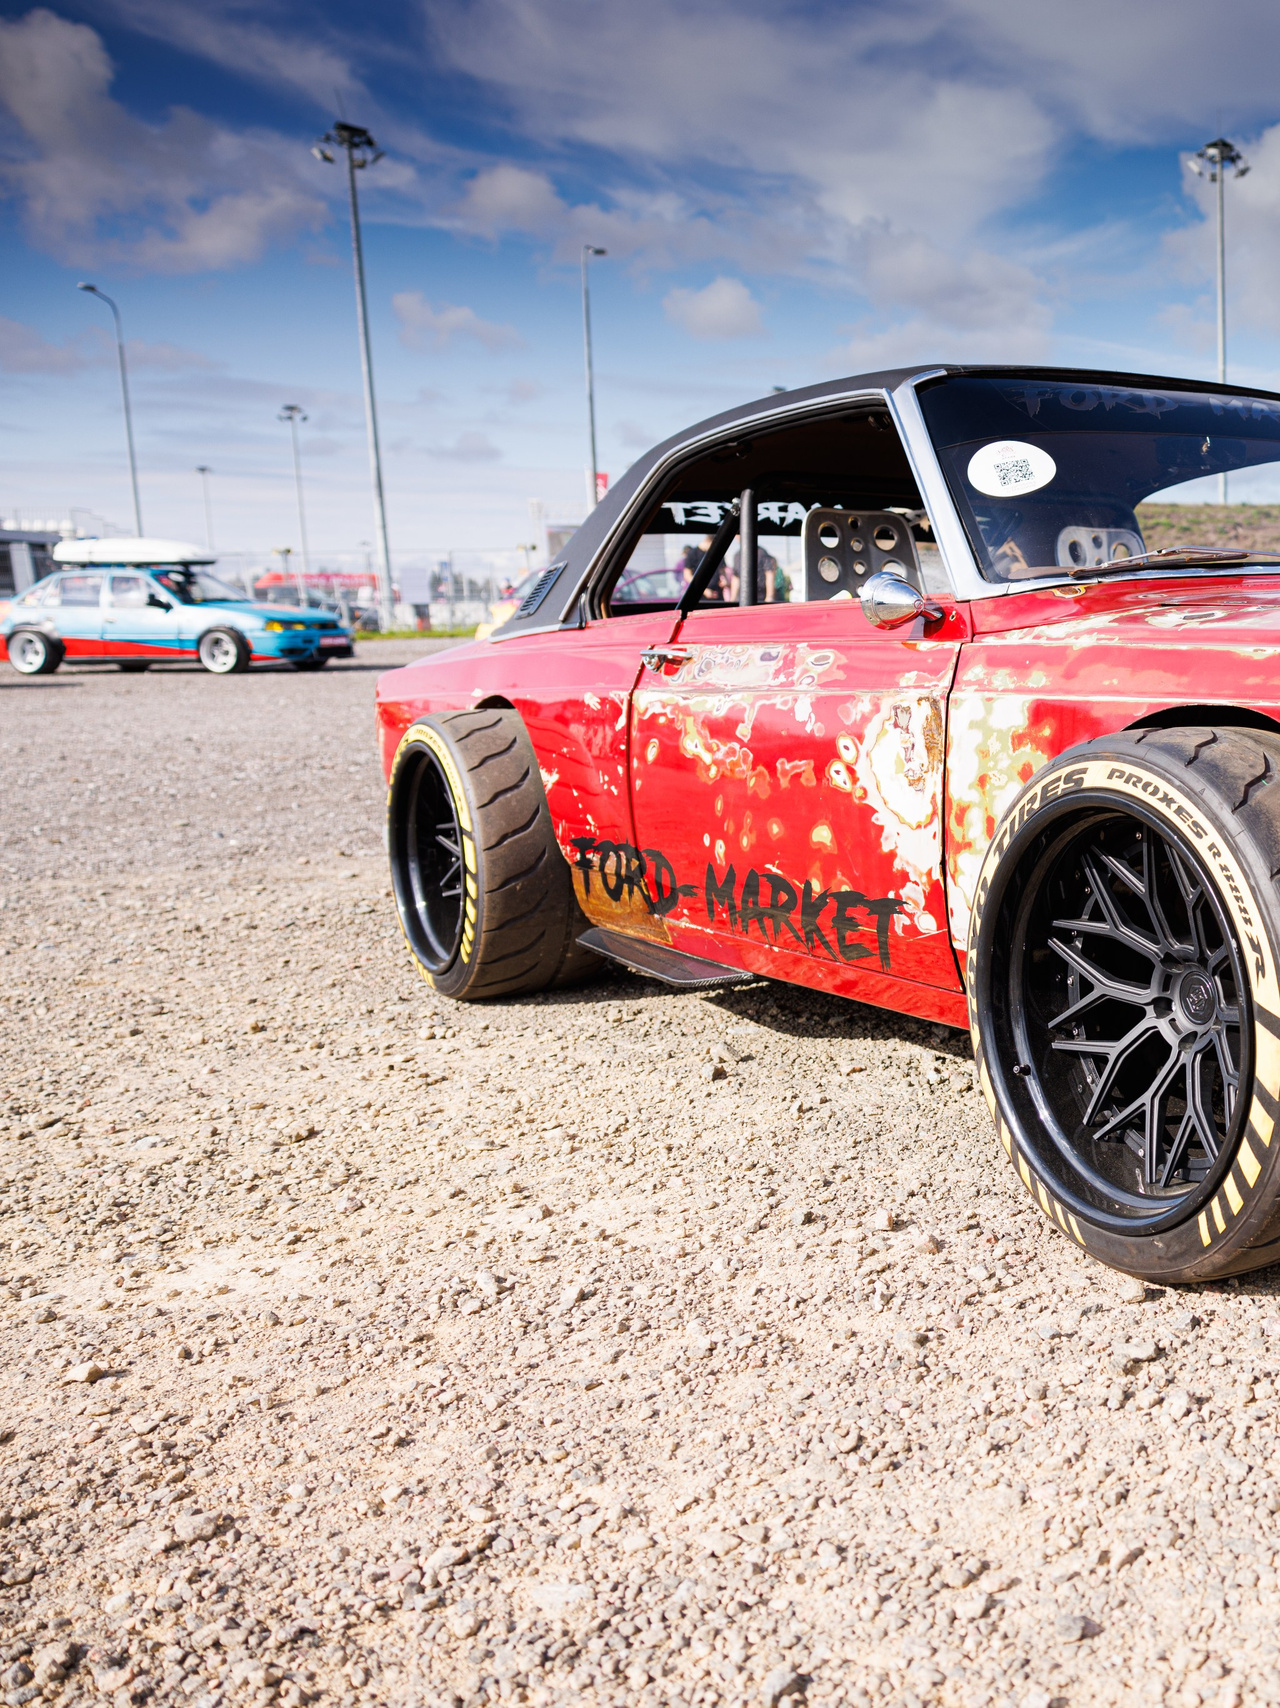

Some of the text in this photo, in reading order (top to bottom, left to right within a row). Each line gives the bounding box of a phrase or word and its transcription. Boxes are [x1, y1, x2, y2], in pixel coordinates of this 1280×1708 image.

[993, 767, 1089, 860] TIRES
[1106, 767, 1208, 841] PROXES
[569, 836, 912, 973] FORD-MARKET
